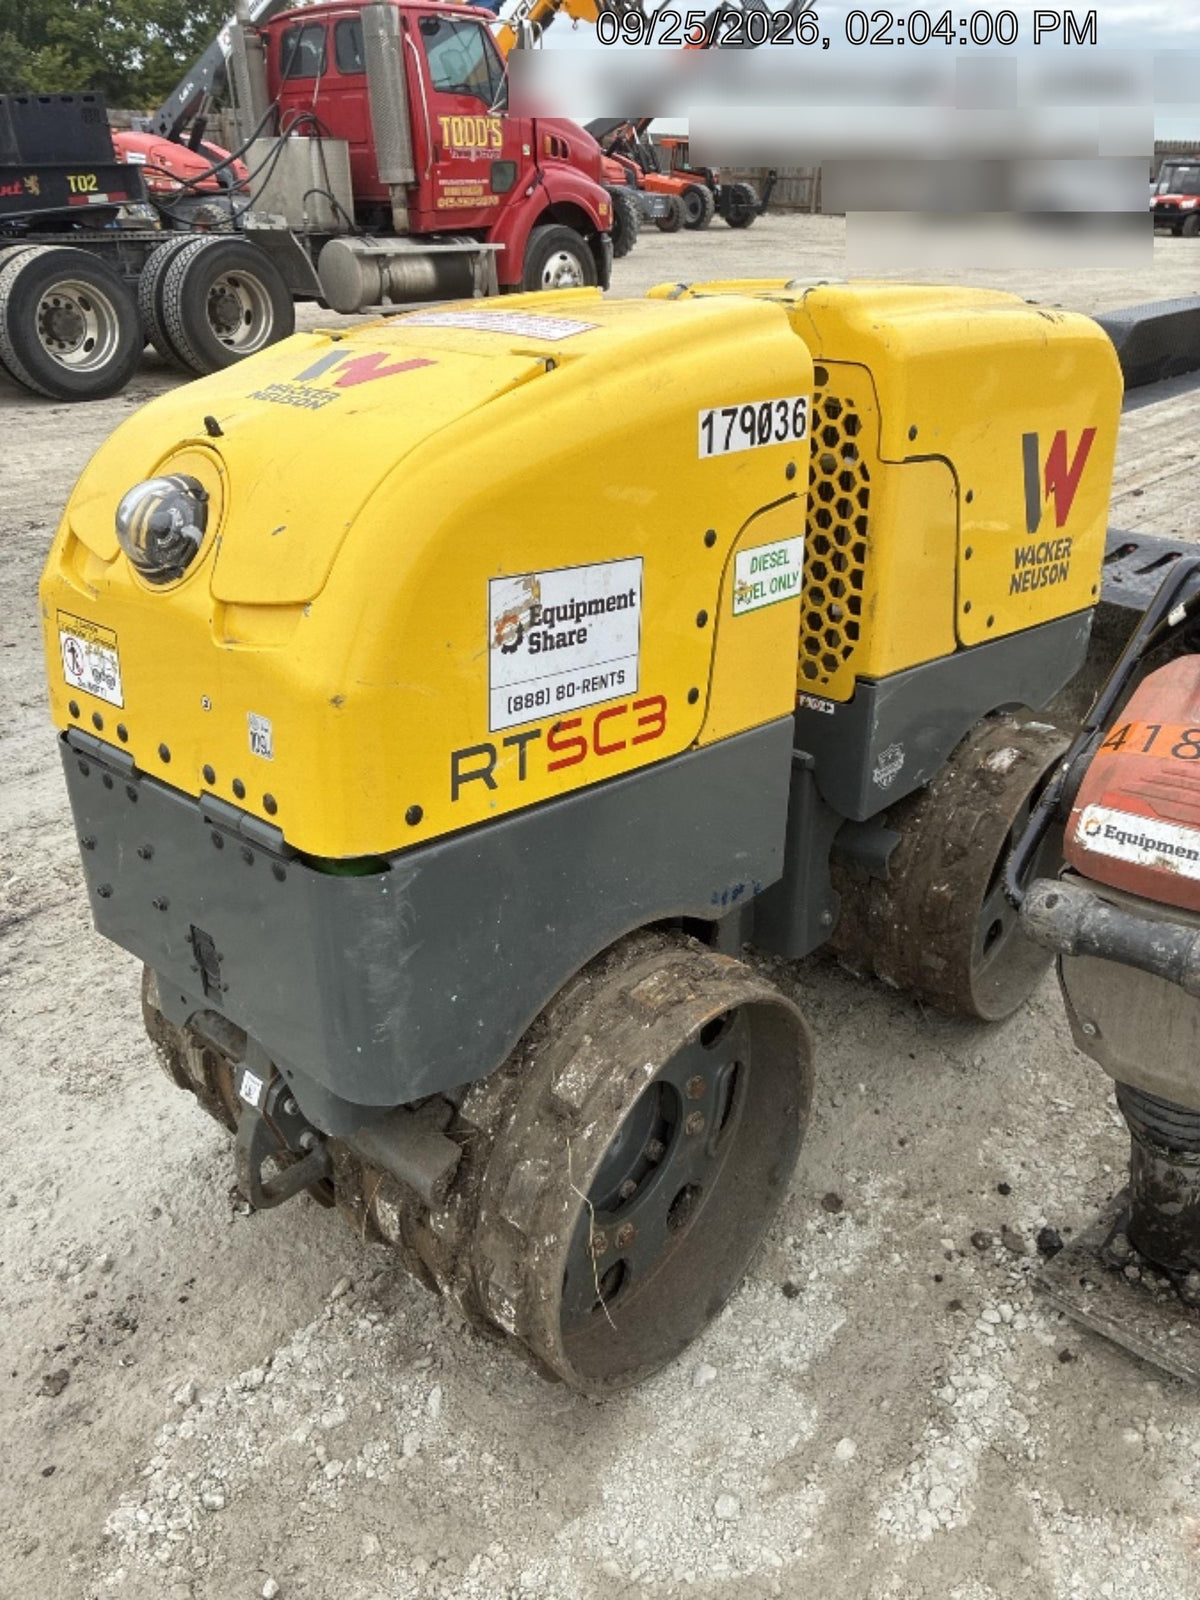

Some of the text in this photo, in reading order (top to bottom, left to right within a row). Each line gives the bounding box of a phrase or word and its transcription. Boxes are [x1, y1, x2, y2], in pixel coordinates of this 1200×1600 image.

[438, 115, 503, 148] TODD'S
[750, 548, 790, 575] DIESEL
[1014, 537, 1073, 569] WACKER
[769, 570, 799, 595] ONLY
[1009, 561, 1070, 596] NEUSON
[528, 588, 637, 629] Equipment
[528, 627, 588, 655] Share
[556, 669, 626, 702] 80-RENTS
[451, 695, 667, 802] RTSC3
